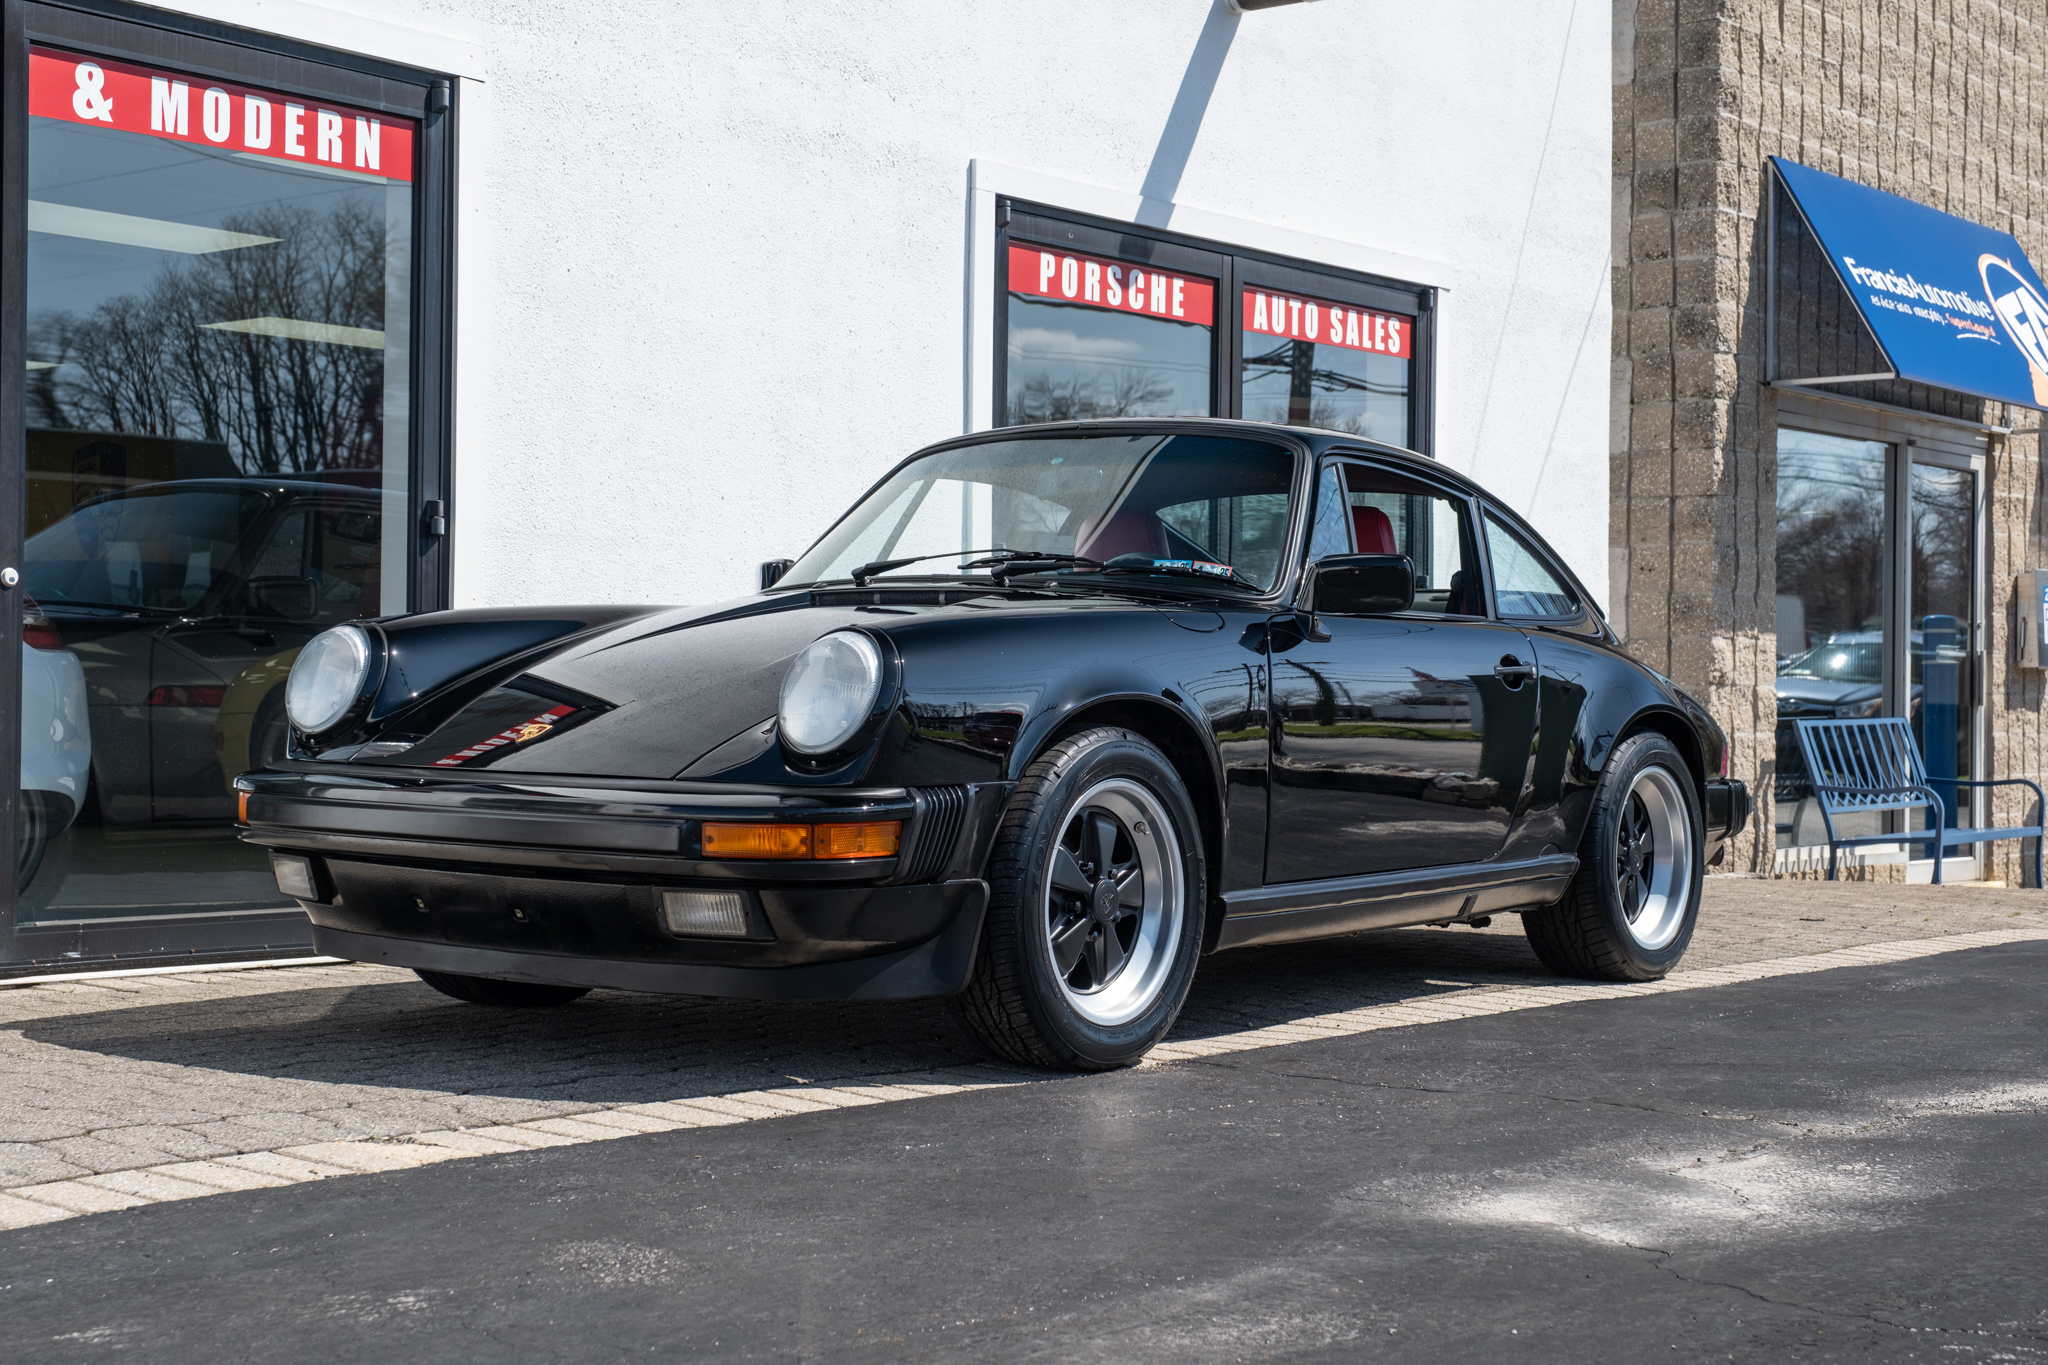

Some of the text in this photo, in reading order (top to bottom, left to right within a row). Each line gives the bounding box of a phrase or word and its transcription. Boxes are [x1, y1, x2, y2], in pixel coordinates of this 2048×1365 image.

[72, 61, 381, 171] & MODERN
[1039, 251, 1186, 318] PORSCHE
[1252, 292, 1401, 354] AUTO SALES
